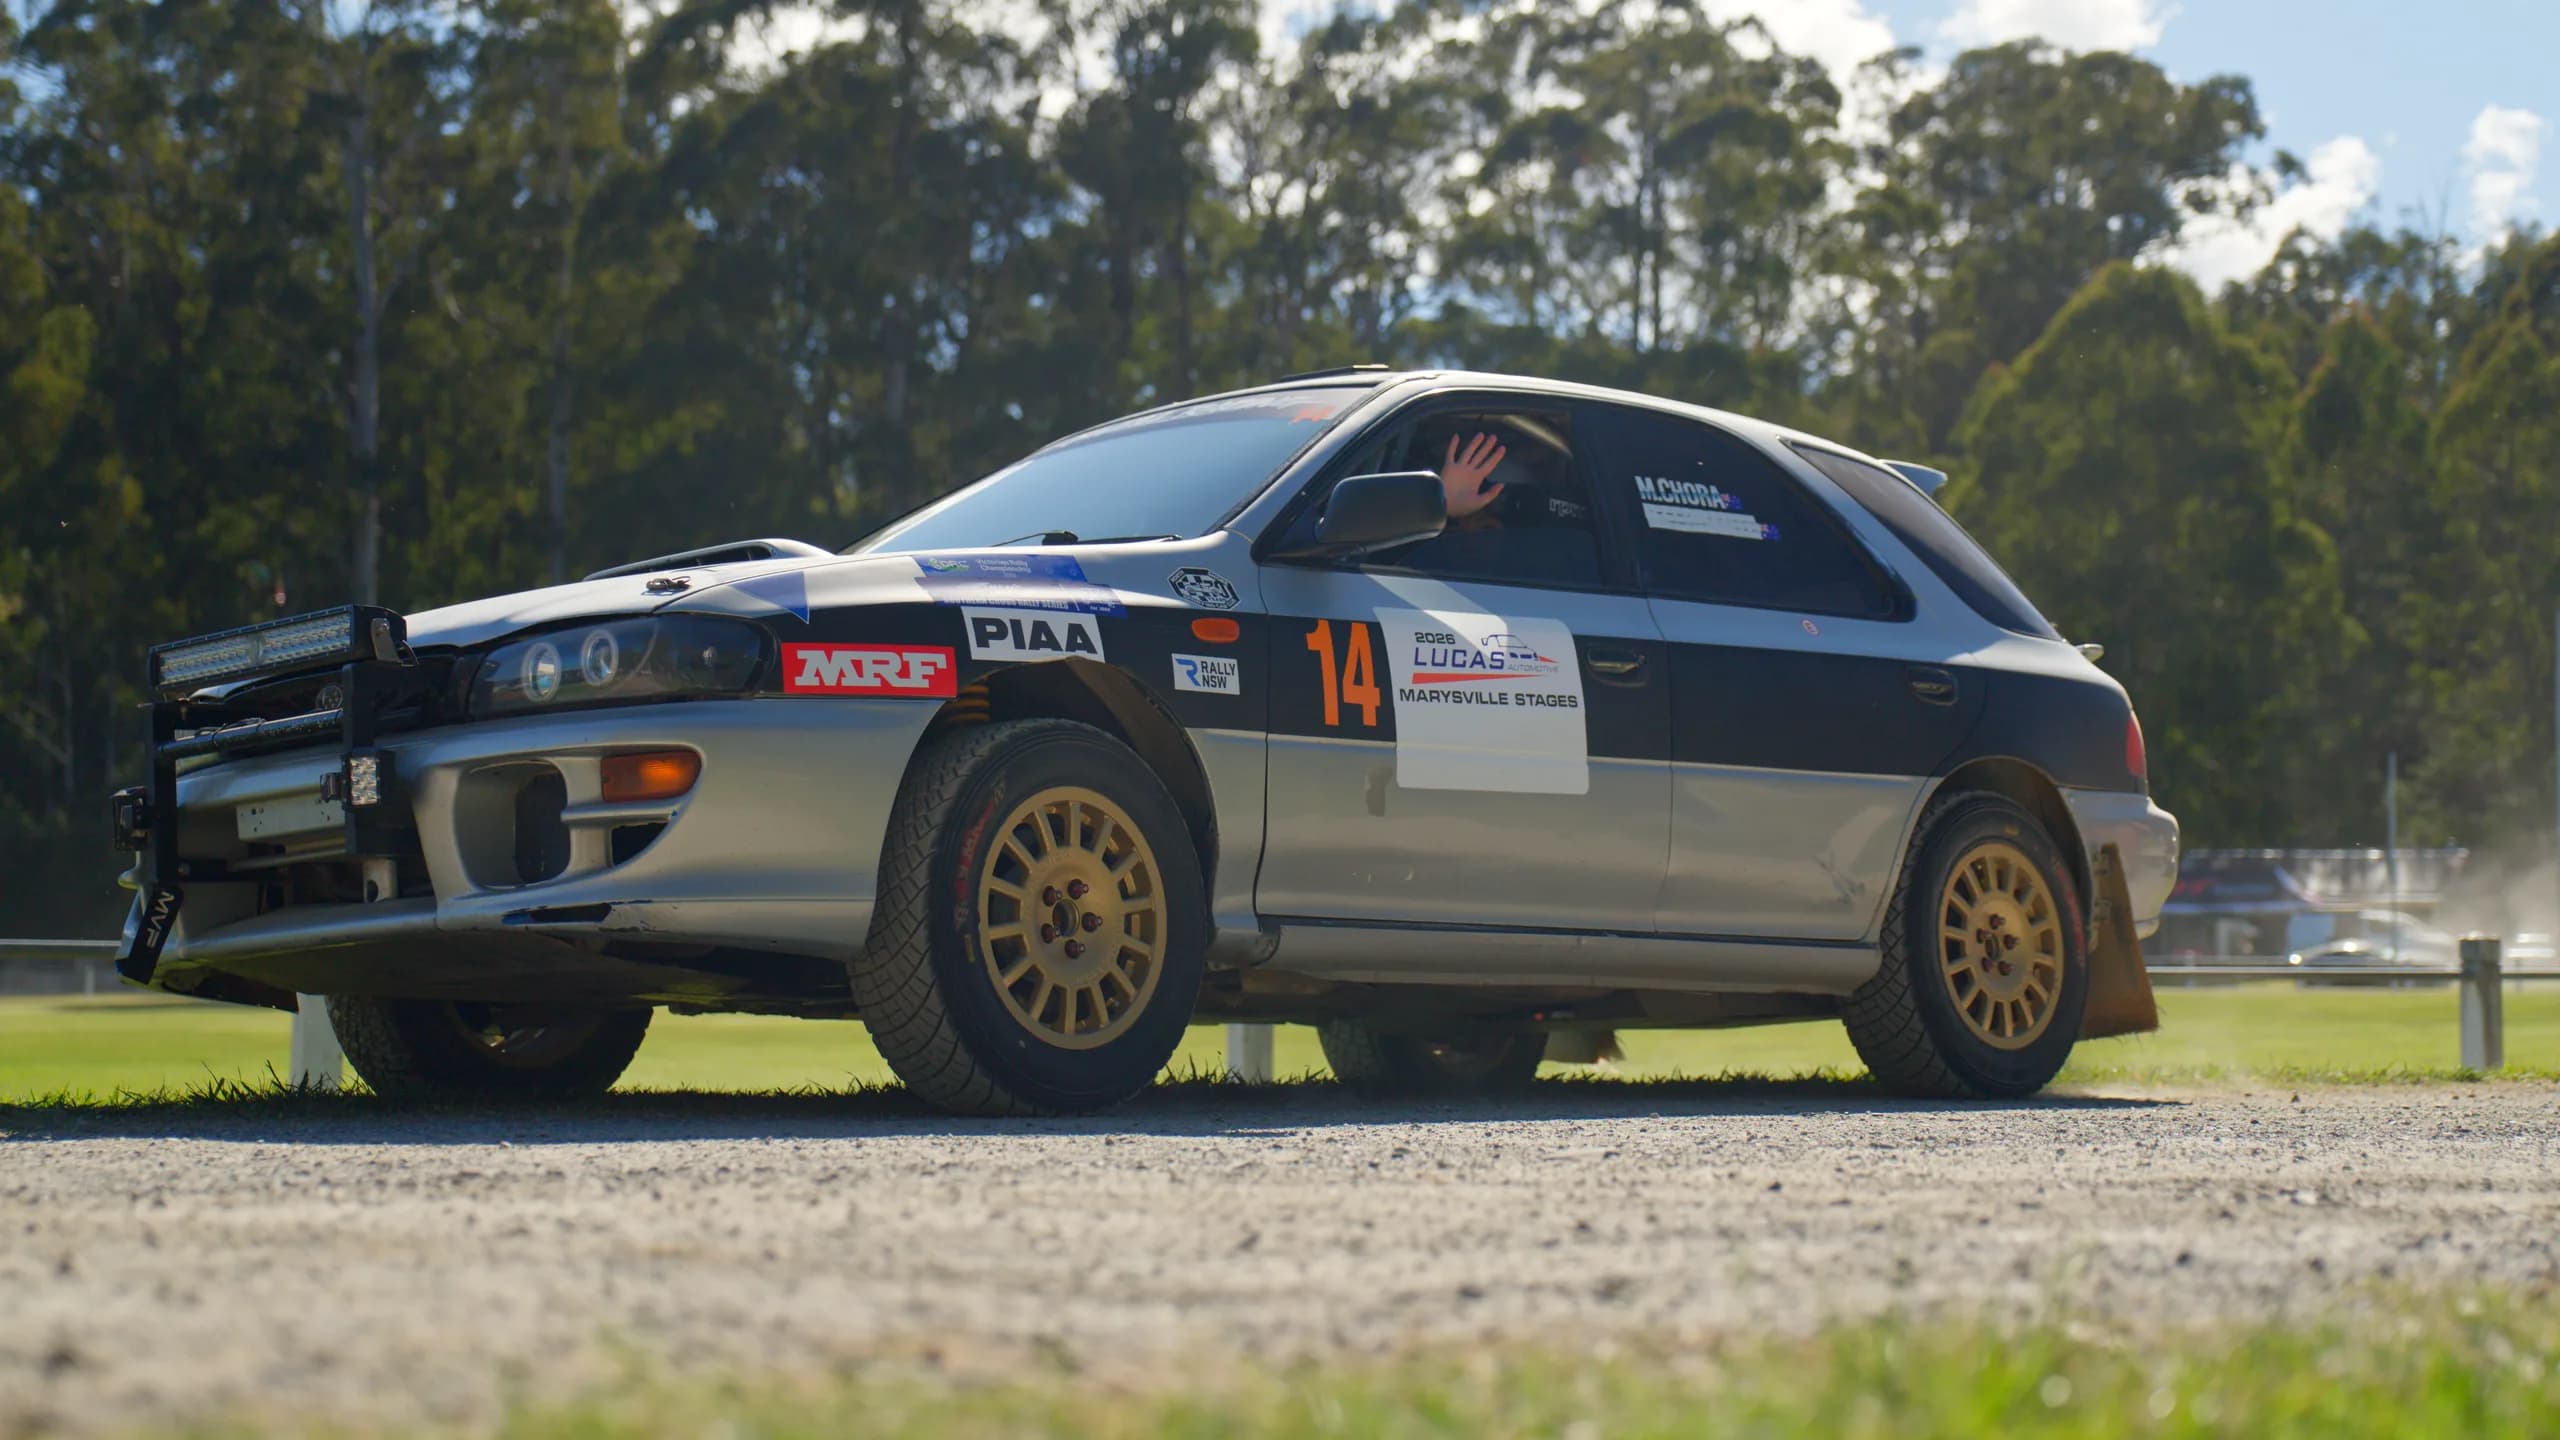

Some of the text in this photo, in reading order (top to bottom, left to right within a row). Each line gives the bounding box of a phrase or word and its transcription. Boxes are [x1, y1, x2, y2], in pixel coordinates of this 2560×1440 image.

[1635, 475, 1728, 509] M.CHORA
[971, 617, 1098, 654] PIAA
[1415, 632, 1456, 645] 2026
[795, 650, 947, 688] MRF
[1201, 661, 1236, 676] RALLY
[1414, 647, 1505, 670] LUCAS
[1202, 675, 1227, 688] NSW
[1305, 618, 1380, 727] 14
[1399, 688, 1578, 708] MARYSVILLE STAGES
